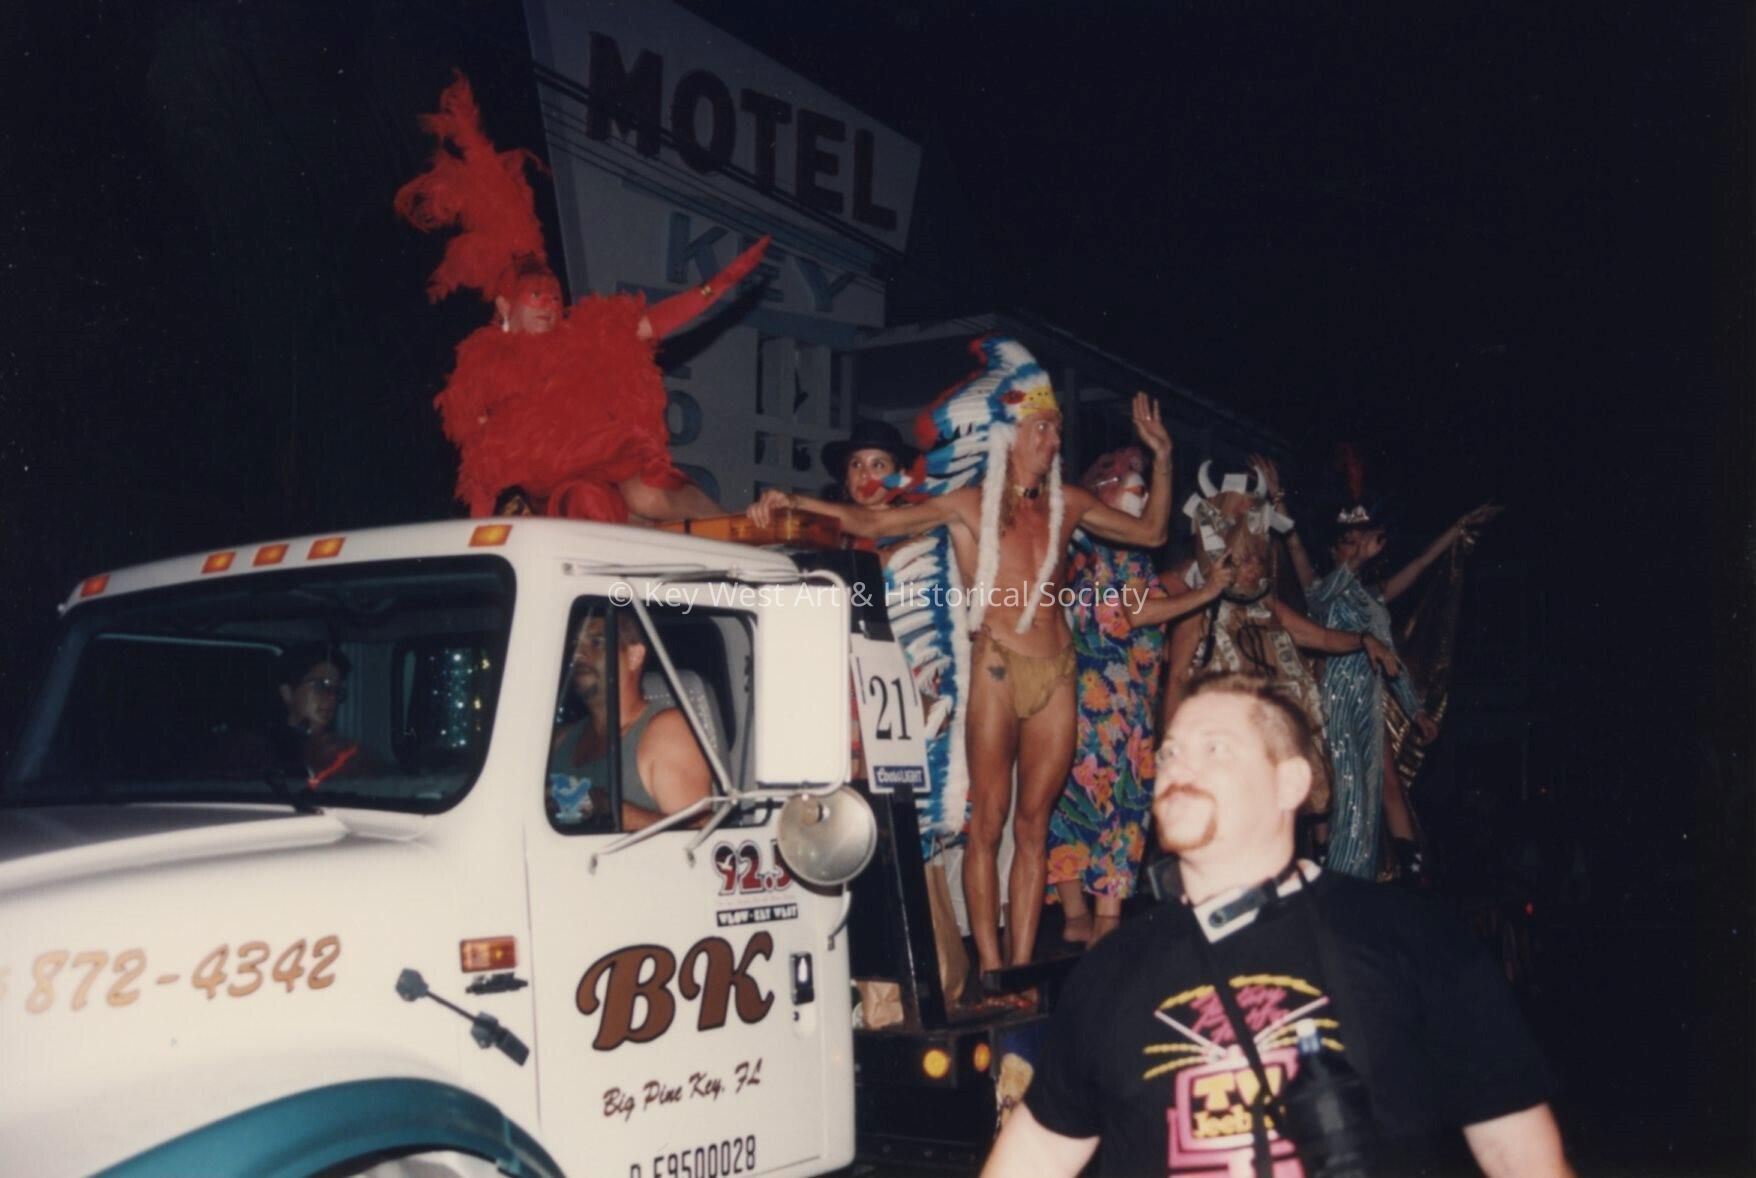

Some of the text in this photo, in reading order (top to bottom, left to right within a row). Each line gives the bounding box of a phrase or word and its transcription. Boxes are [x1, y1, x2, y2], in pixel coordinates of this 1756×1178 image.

[586, 31, 898, 232] MOTEL
[869, 675, 912, 740] 21
[25, 935, 342, 1014] 872-4342
[576, 931, 775, 1051] BK
[603, 1087, 636, 1122] Big
[643, 1080, 682, 1111] Pine
[734, 1057, 763, 1094] FL
